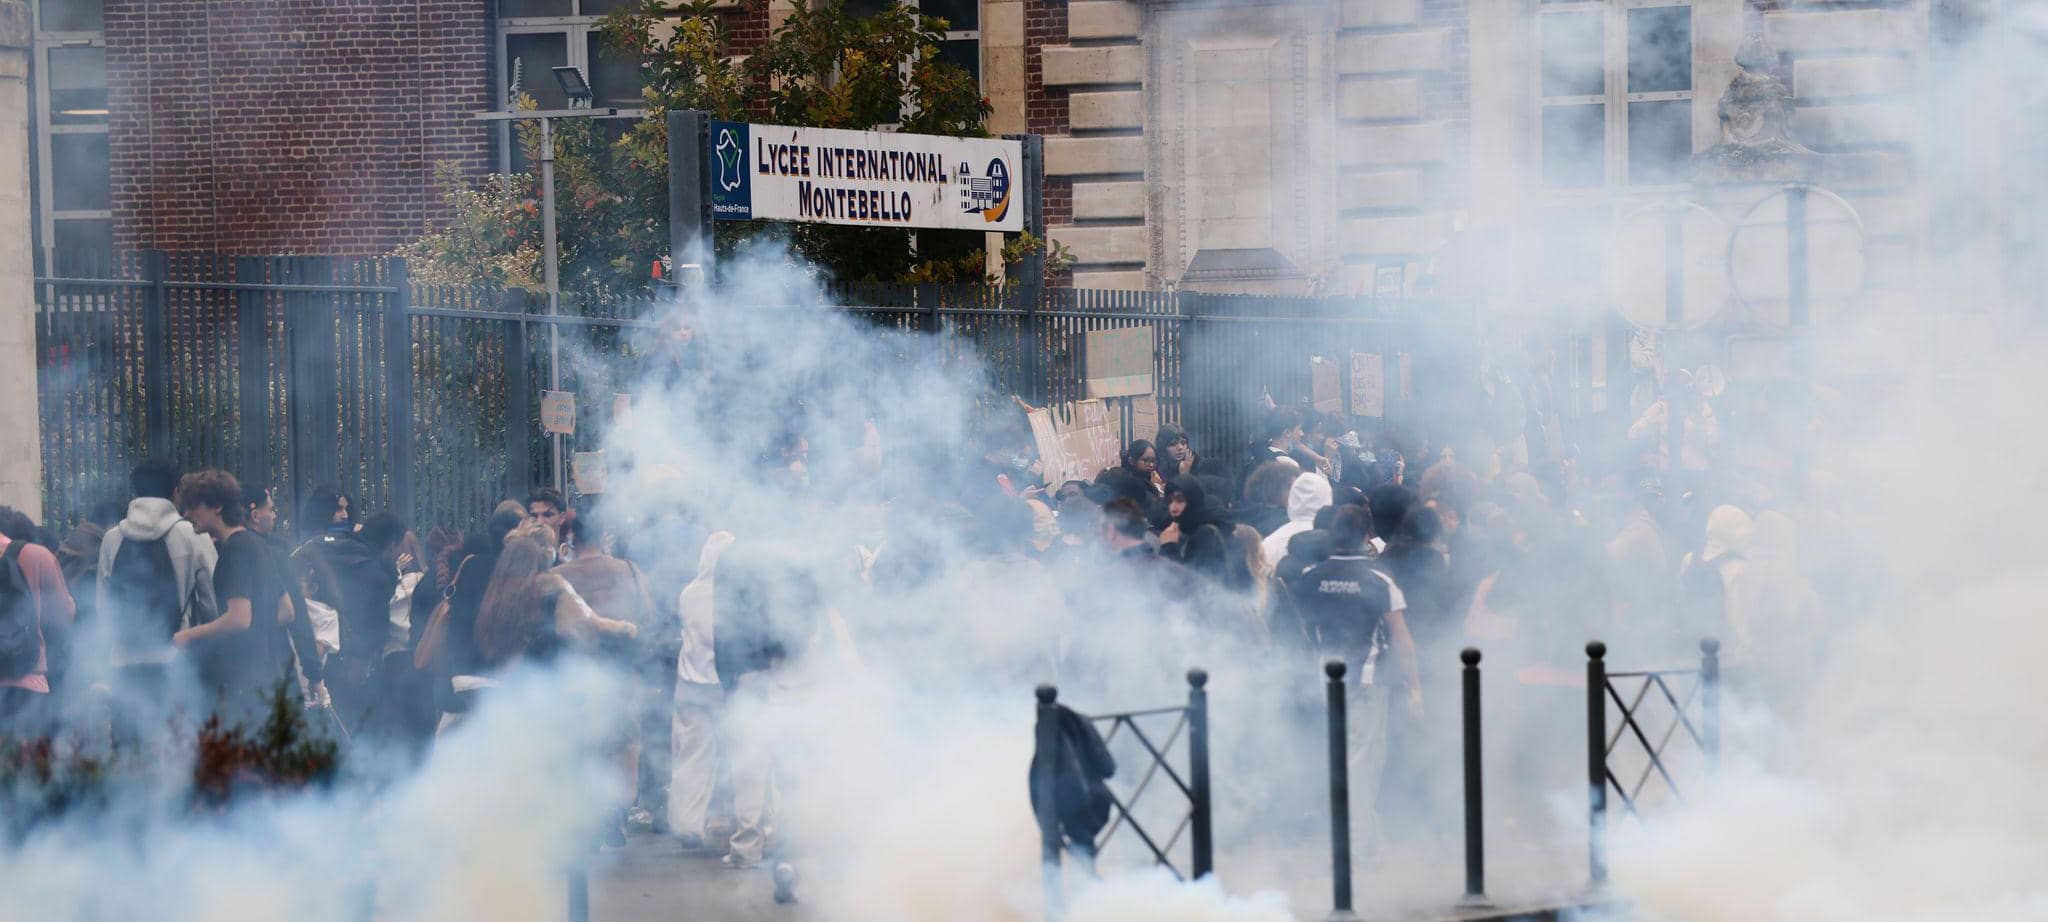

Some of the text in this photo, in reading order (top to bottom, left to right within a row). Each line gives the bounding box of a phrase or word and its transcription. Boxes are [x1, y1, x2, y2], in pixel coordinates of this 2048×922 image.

[758, 131, 947, 183] LYCÉE INTERNATIONAL
[799, 181, 912, 221] MONTEBELLO
